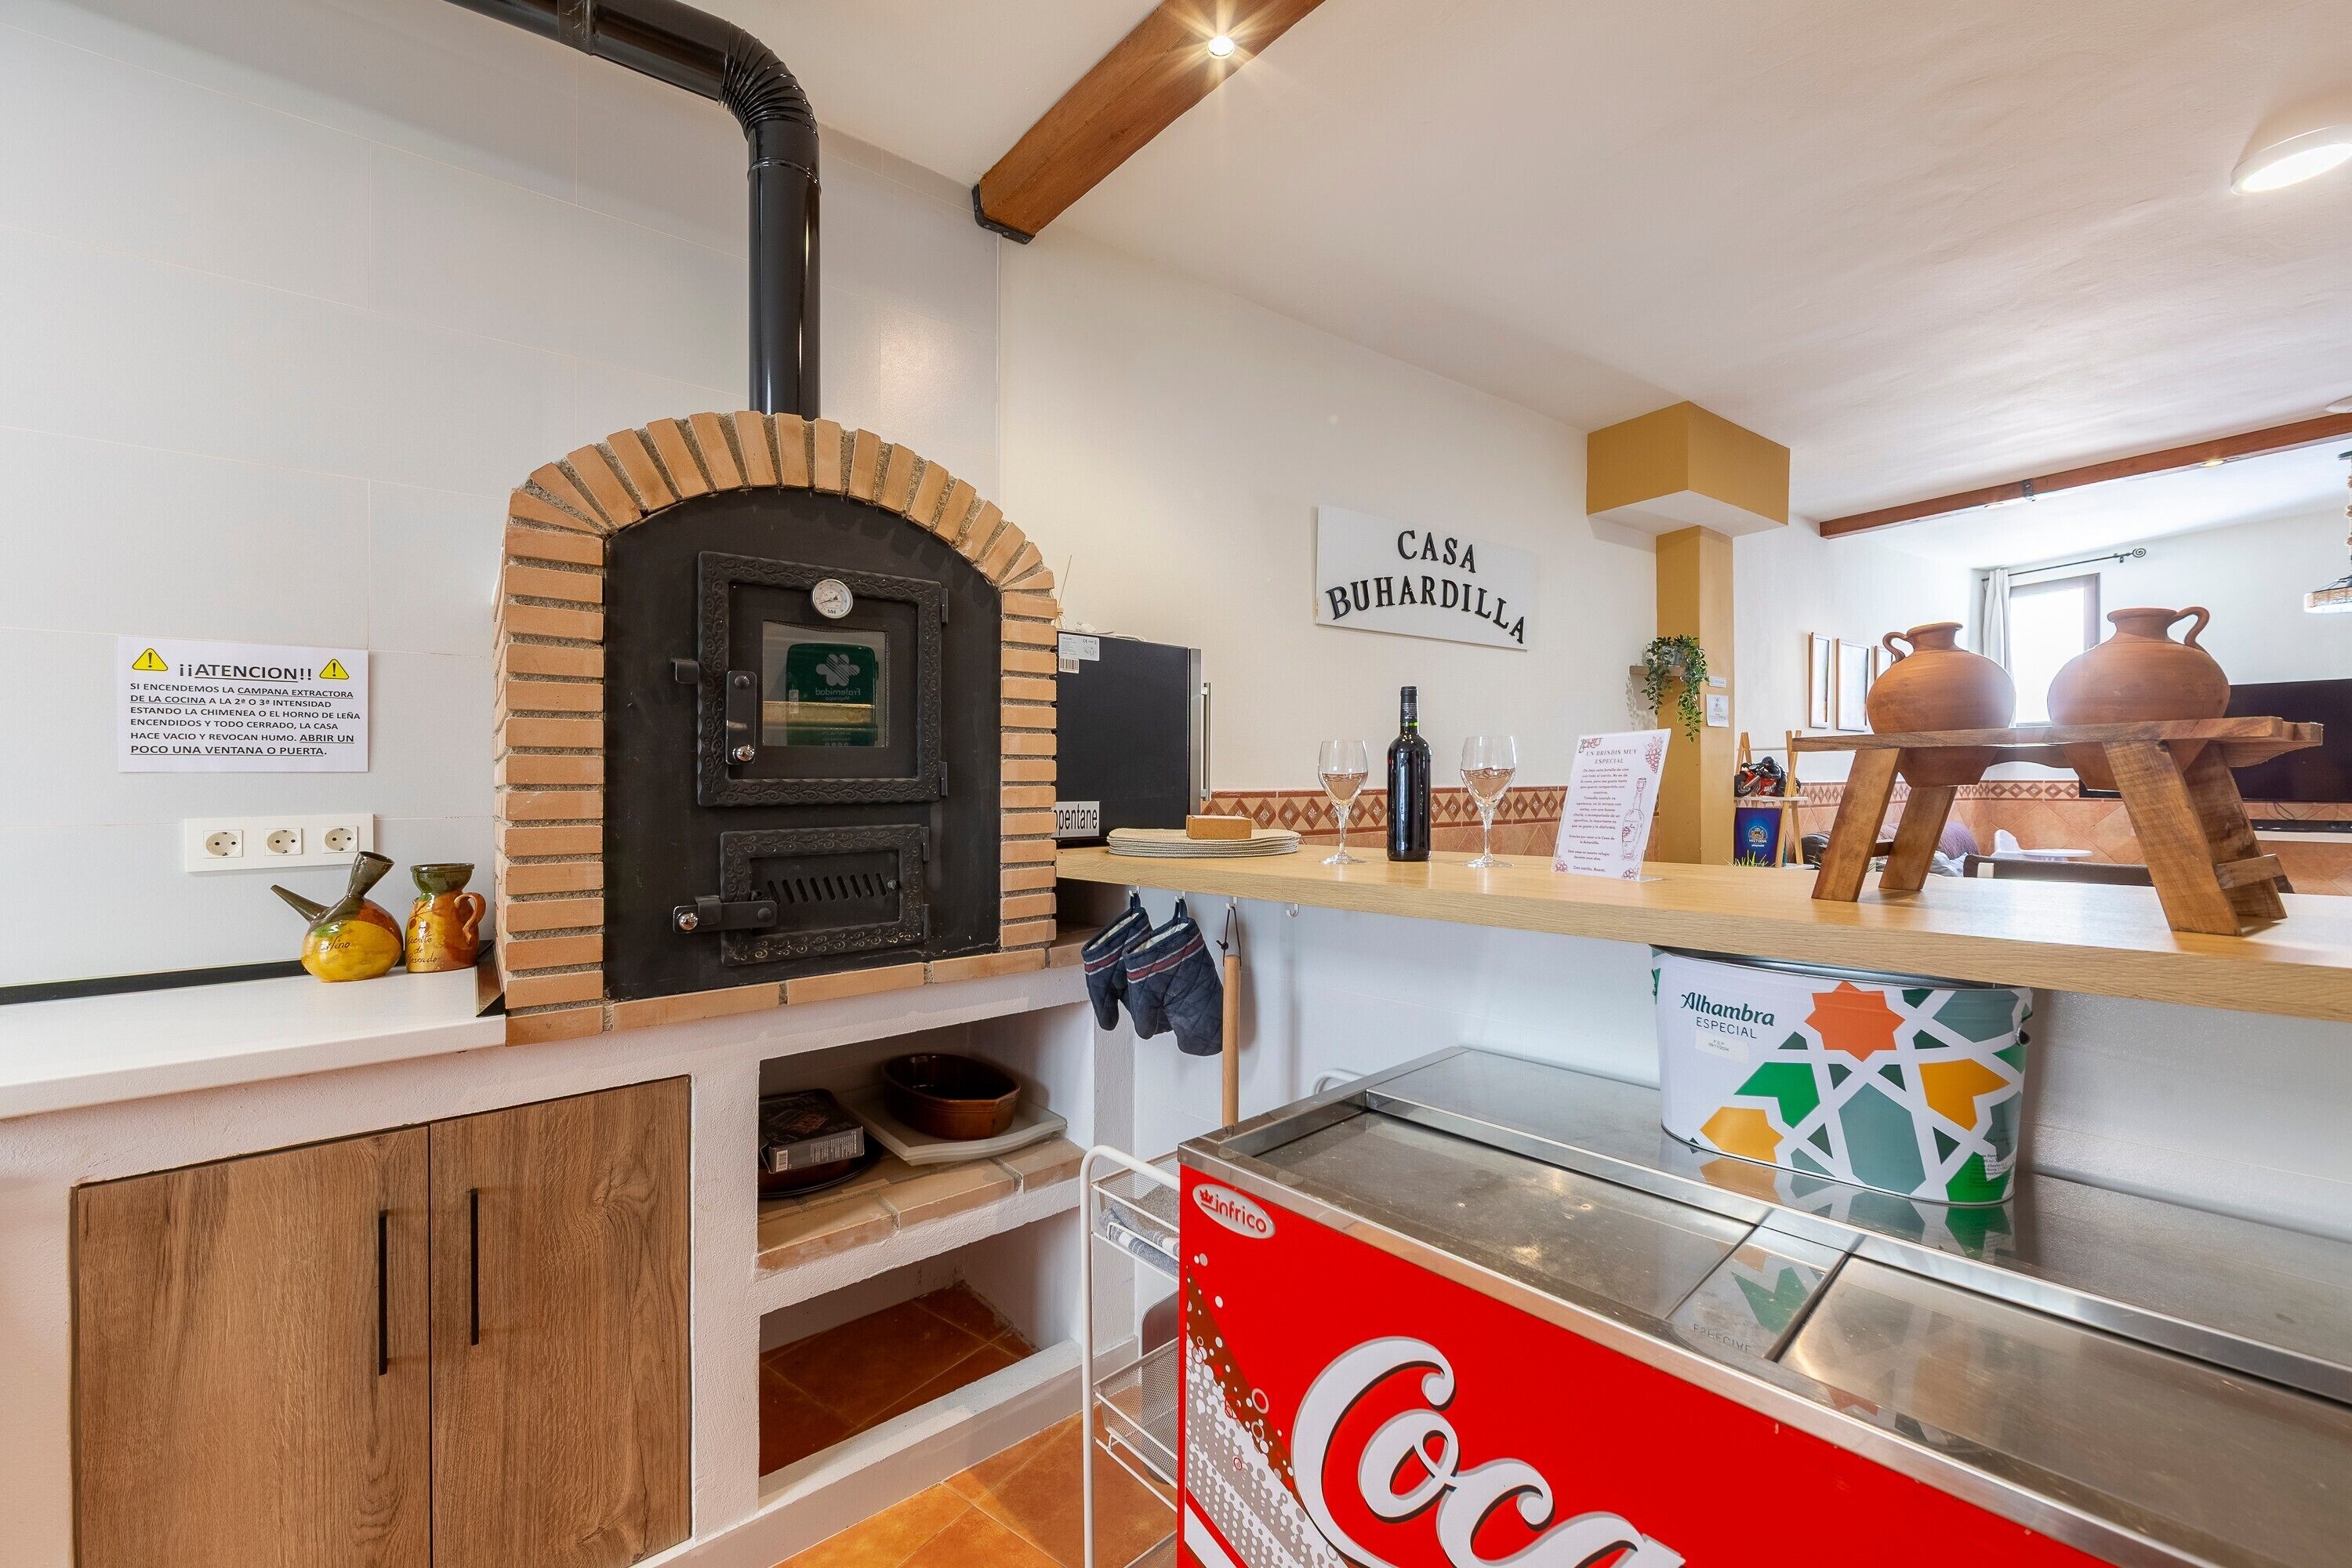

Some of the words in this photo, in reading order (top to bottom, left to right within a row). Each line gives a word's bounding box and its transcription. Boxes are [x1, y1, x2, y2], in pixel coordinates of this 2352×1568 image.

[1397, 530, 1476, 573] CASA
[1326, 575, 1524, 644] BUHARDILLA
[180, 663, 311, 681] ¡¡ATENCION!!
[143, 684, 219, 693] ENCENDEMOS
[292, 689, 354, 698] EXTRACTORA
[273, 699, 332, 708] INTENSIDAD
[246, 721, 297, 730] CERRADO,
[336, 711, 361, 720] LEÑA
[172, 746, 201, 754] UNA
[1680, 992, 1775, 1026] Alhambra
[1696, 1017, 1757, 1039] ESPECIAL
[1216, 1194, 1267, 1232] infrico
[1290, 1335, 1686, 1568] Coca
